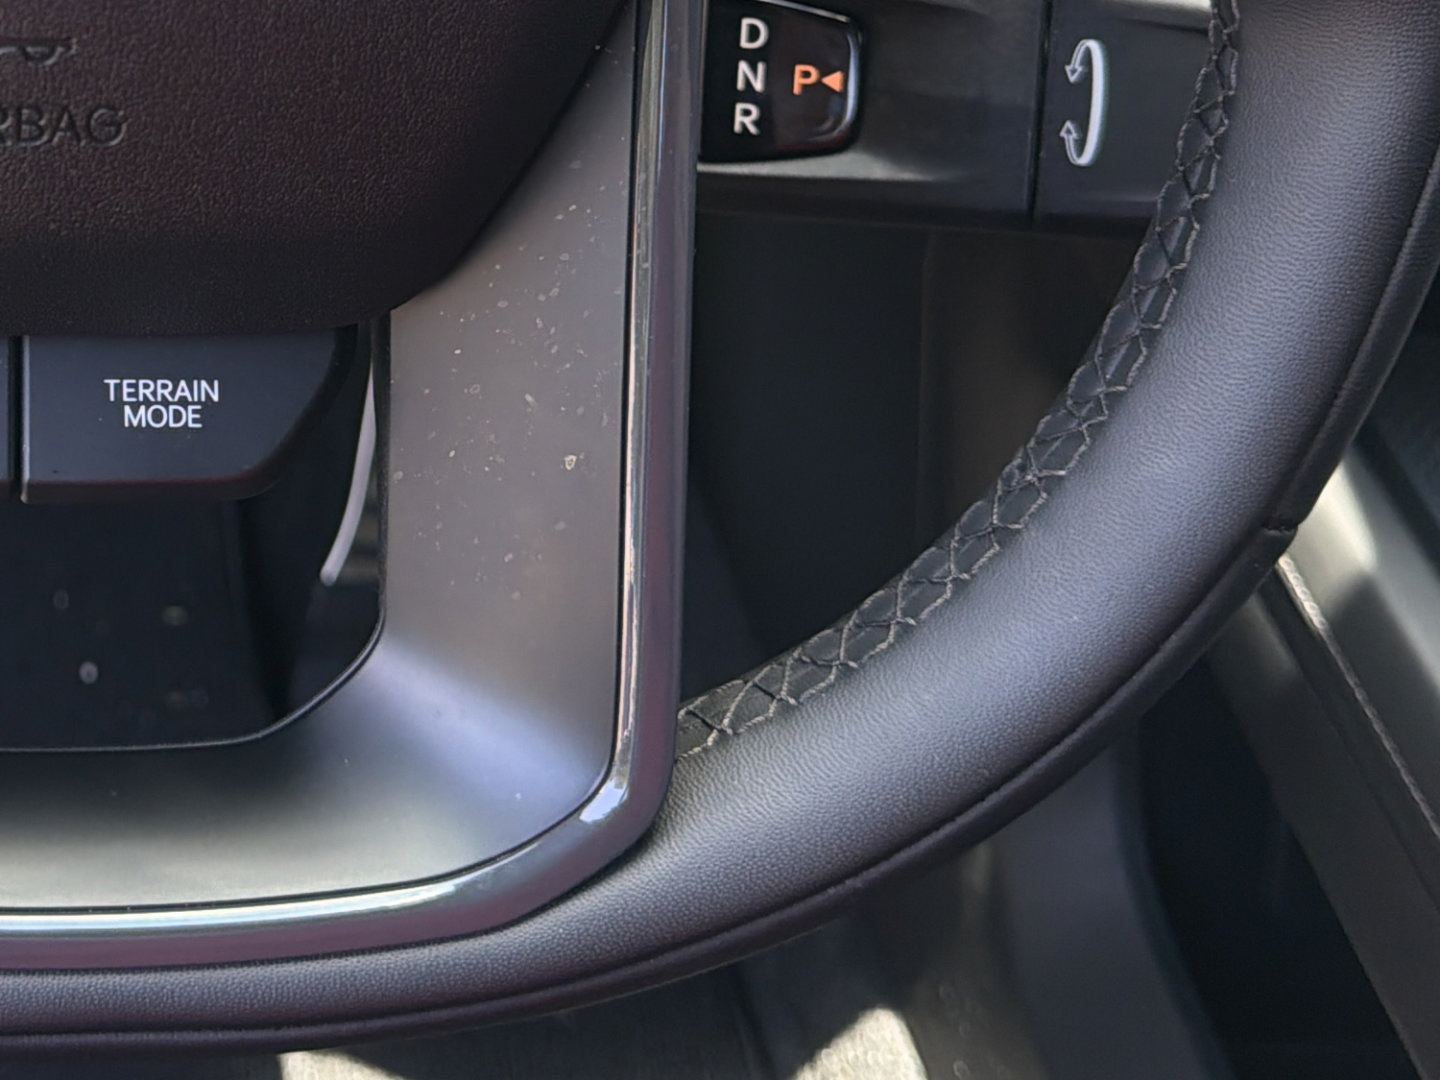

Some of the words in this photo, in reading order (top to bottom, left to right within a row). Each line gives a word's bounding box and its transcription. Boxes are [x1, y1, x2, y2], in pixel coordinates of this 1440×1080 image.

[740, 18, 768, 49] D
[737, 61, 765, 92] N
[793, 65, 819, 95] P
[734, 103, 760, 135] R
[104, 379, 219, 402] TERRAIN
[124, 405, 202, 428] MODE
